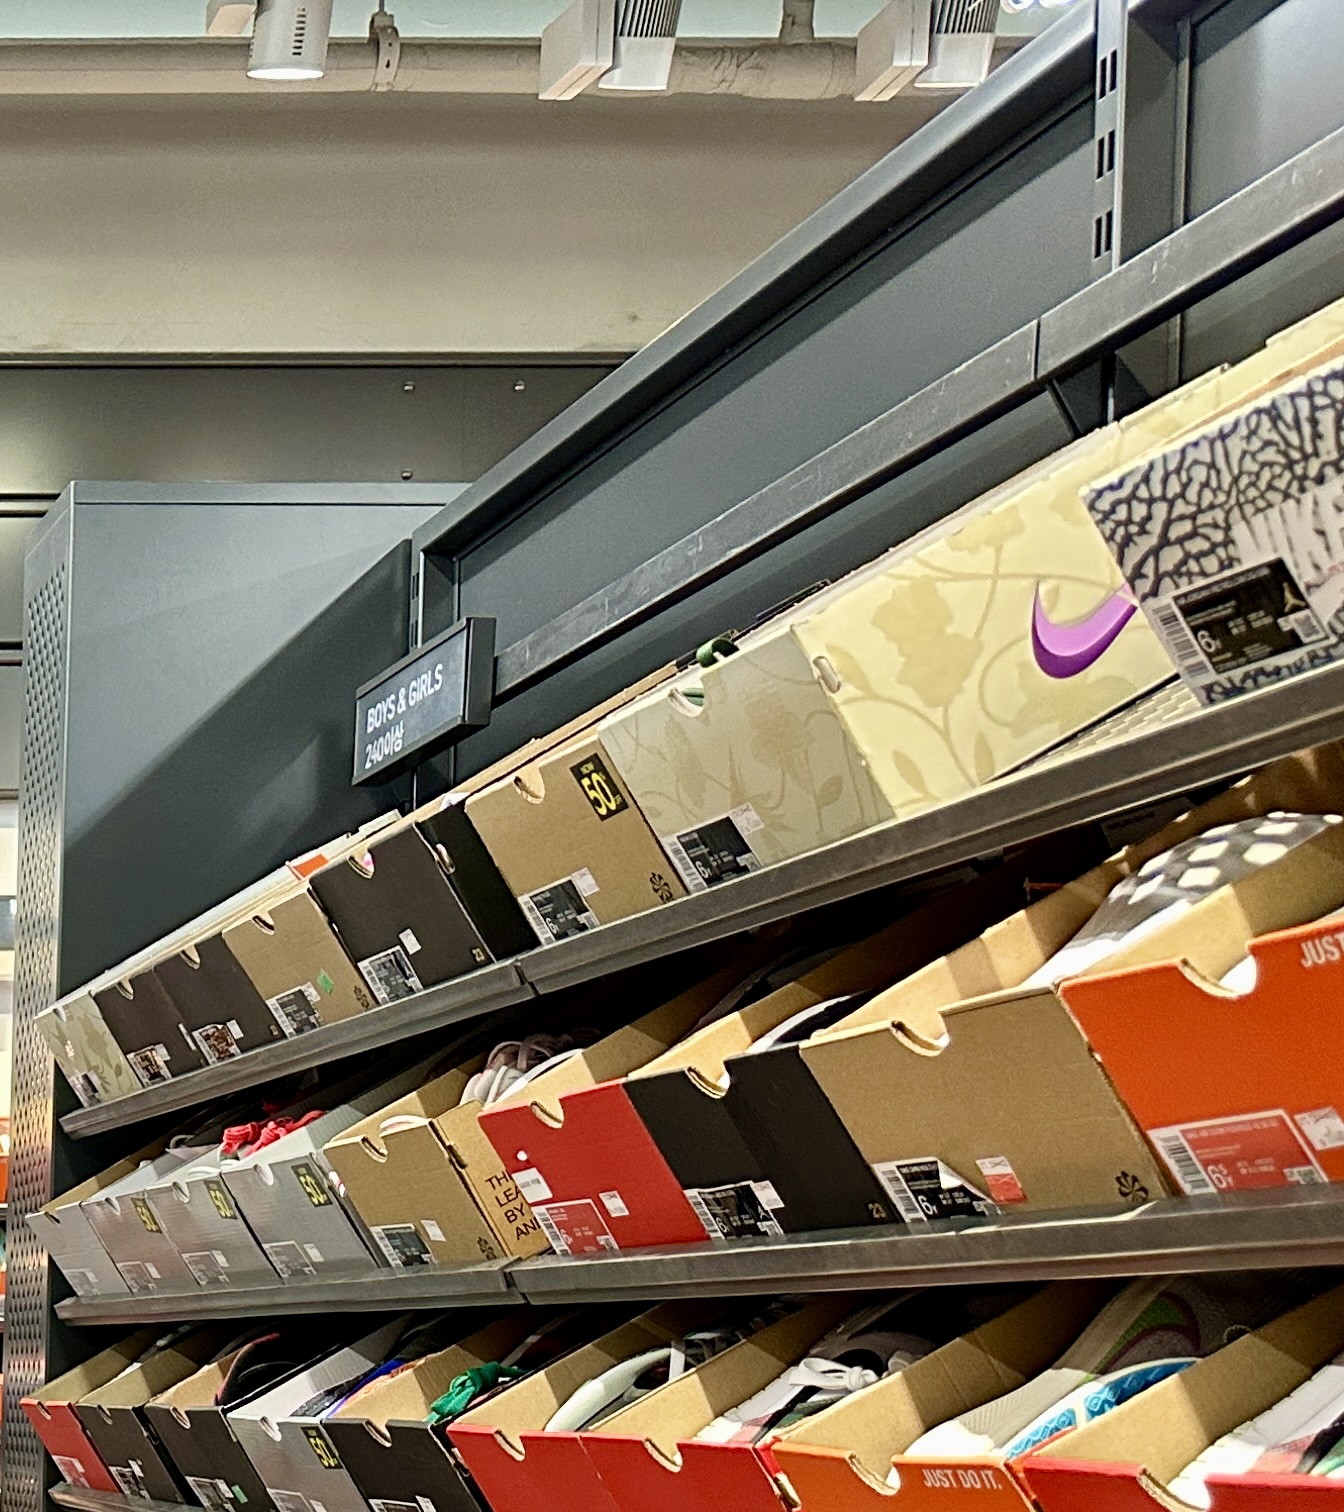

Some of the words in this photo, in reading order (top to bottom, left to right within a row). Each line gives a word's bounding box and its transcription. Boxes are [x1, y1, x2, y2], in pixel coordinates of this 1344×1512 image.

[366, 693, 396, 734] BOYS
[396, 687, 407, 714] &
[408, 663, 444, 707] GIRLS
[504, 1203, 526, 1224] BY
[515, 1216, 542, 1240] AN
[922, 1468, 959, 1489] JUST
[960, 1469, 981, 1490] DO
[982, 1470, 1003, 1491] IT.
